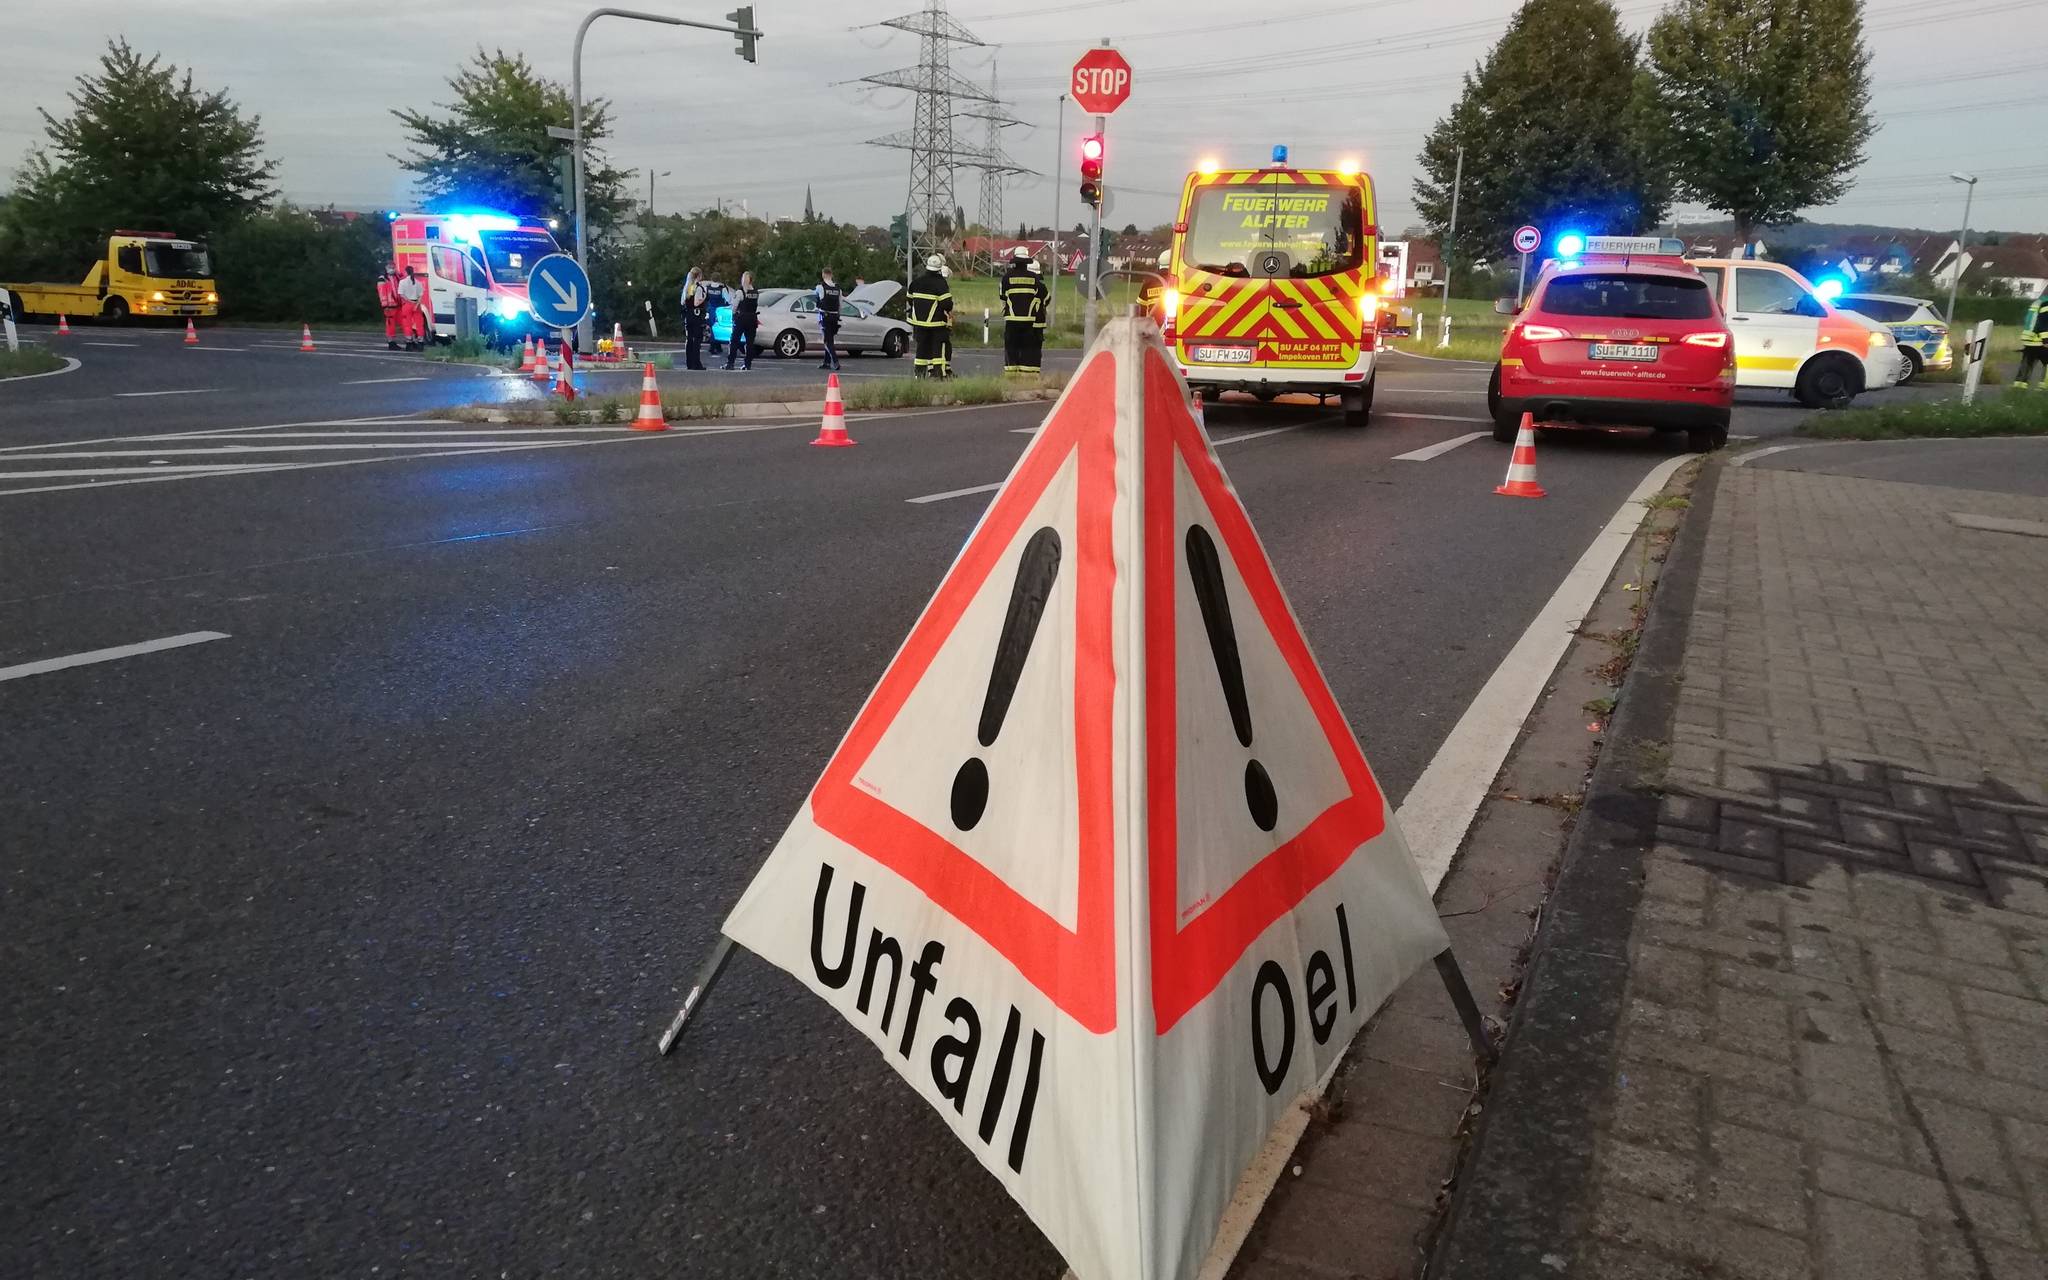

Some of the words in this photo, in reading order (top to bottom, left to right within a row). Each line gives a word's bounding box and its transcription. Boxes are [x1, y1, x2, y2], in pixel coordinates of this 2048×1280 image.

[1076, 67, 1128, 95] STOP
[1222, 193, 1329, 212] FEUERWEHR
[1240, 214, 1310, 229] ALFTER
[1588, 241, 1657, 251] FEUERWEHR
[176, 280, 196, 288] ADAC
[1279, 343, 1291, 352] SU
[1292, 343, 1309, 352] ALF
[1322, 344, 1340, 352] MTF
[1596, 345, 1609, 356] SU
[1615, 346, 1629, 356] FW
[1631, 346, 1657, 358] 1110
[1199, 349, 1212, 359] SU
[1217, 349, 1230, 359] FW
[1233, 350, 1250, 360] 194
[1279, 353, 1321, 361] Impekoven
[1322, 353, 1341, 361] MTF
[1251, 903, 1357, 1096] Oel
[810, 862, 1045, 1175] Unfall
